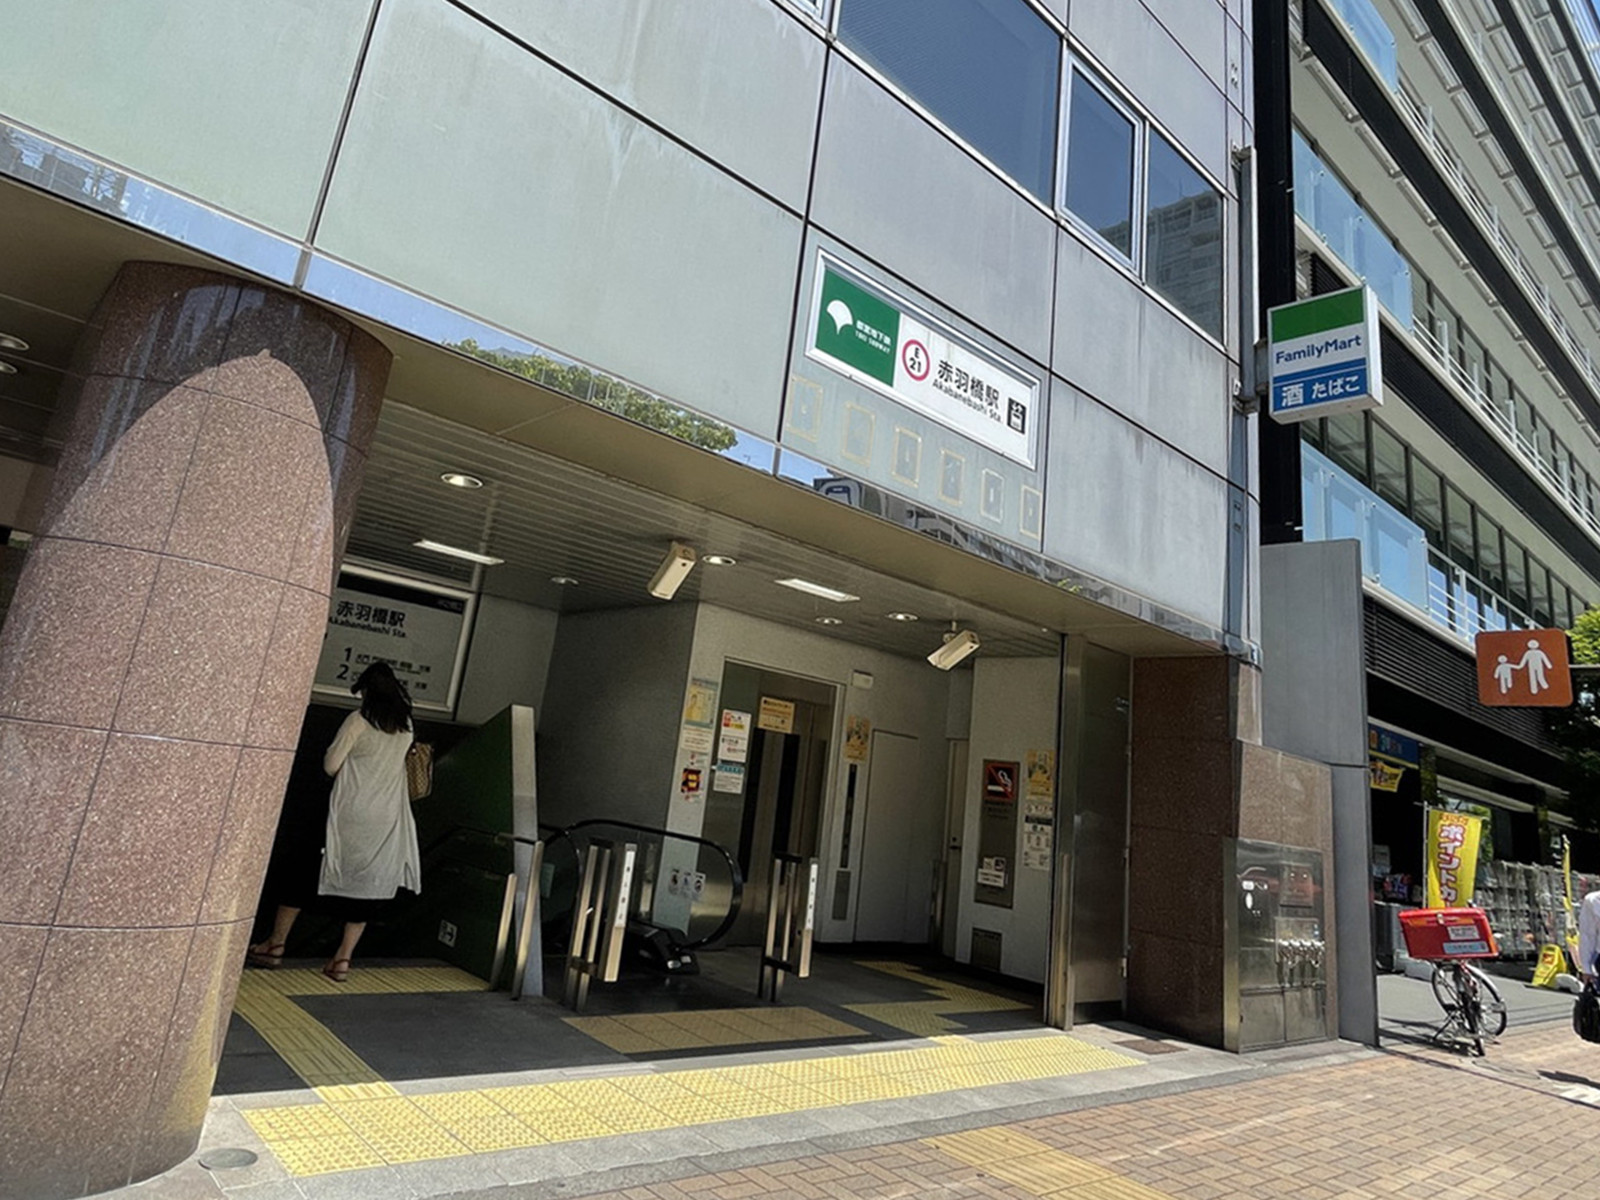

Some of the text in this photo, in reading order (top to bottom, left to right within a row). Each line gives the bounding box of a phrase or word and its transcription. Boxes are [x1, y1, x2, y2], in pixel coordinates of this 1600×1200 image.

[914, 347, 919, 359] E
[1275, 335, 1361, 364] FamilyMart
[909, 357, 921, 373] 21
[932, 378, 988, 415] Akabanebashi
[937, 360, 1000, 410] 赤羽橋駅
[1281, 375, 1361, 407] 酒 たばこ
[335, 600, 406, 628] 赤羽橋駅
[344, 647, 352, 662] 1
[336, 664, 349, 681] 2
